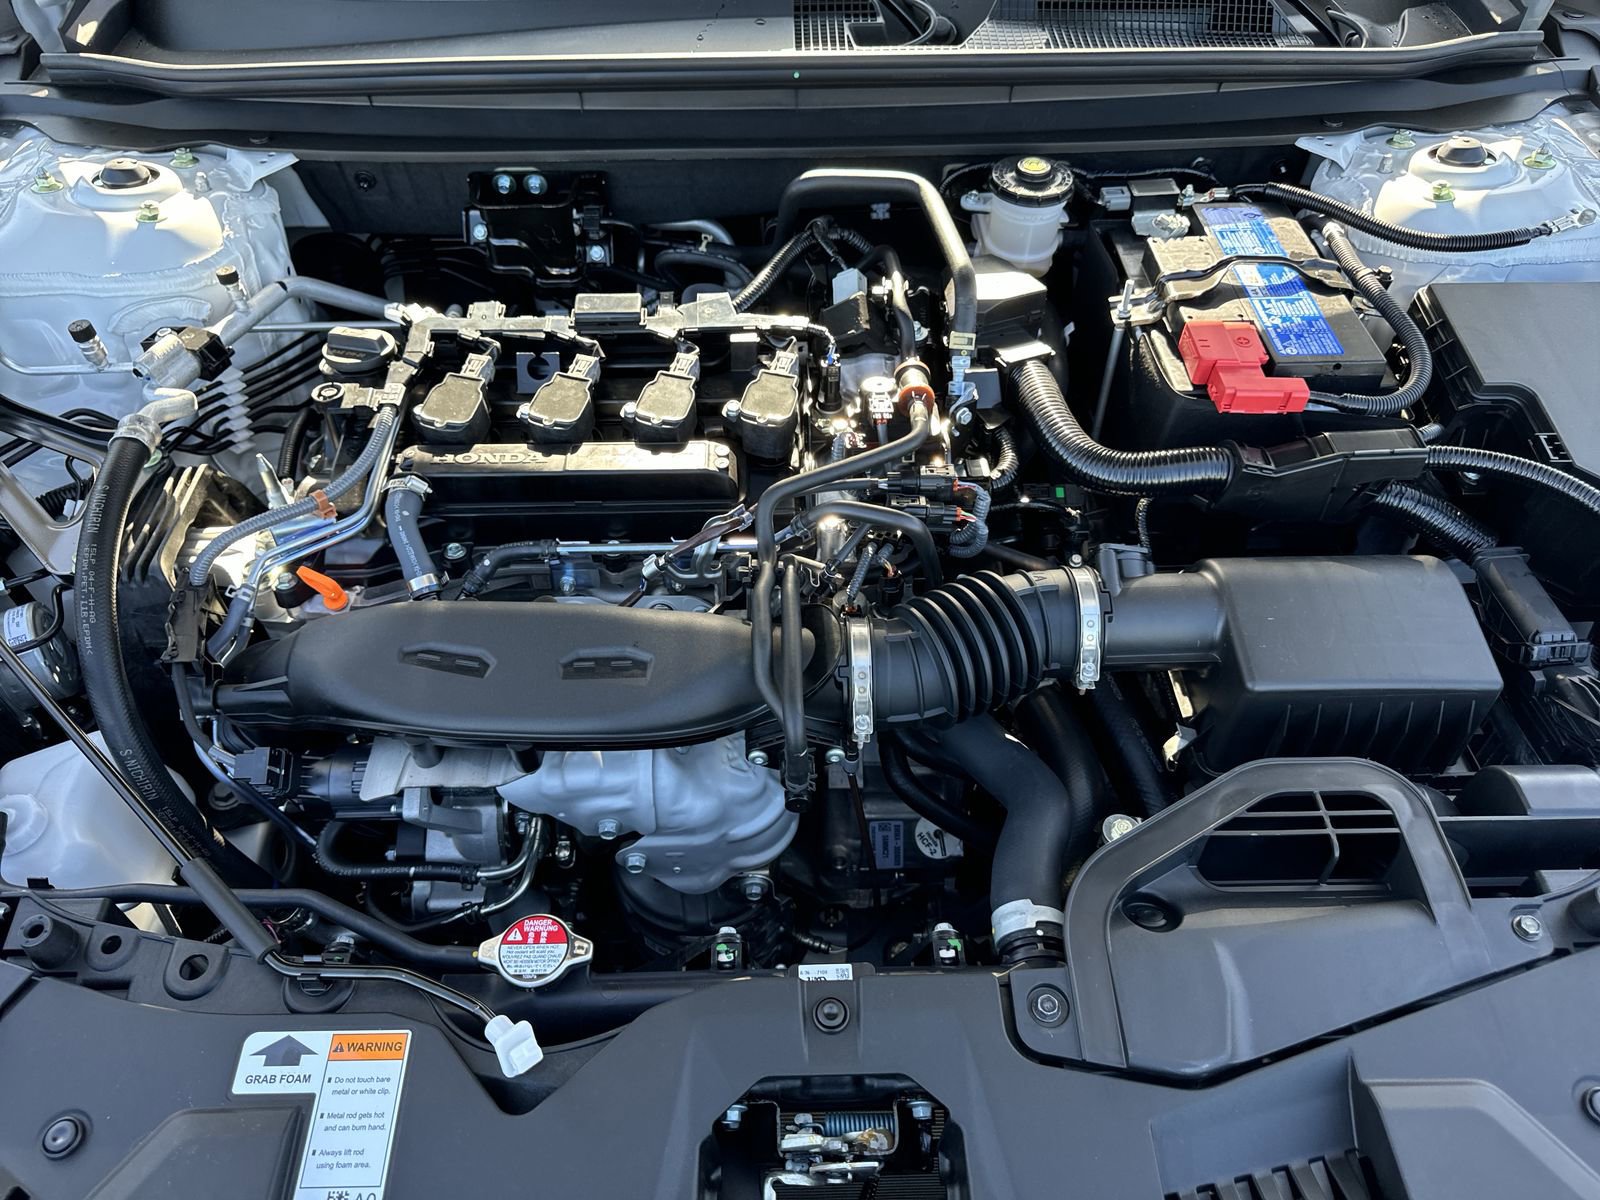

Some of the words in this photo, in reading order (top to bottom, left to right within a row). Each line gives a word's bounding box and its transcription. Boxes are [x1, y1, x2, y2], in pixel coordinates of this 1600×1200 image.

[433, 452, 547, 464] HONDA
[347, 1042, 403, 1052] WARNING
[245, 1074, 277, 1084] GRAB
[279, 1074, 312, 1084] FOAM
[358, 1112, 373, 1121] gets
[373, 1111, 385, 1119] hot
[318, 1149, 342, 1157] Always
[316, 1162, 334, 1170] using
[335, 1161, 352, 1169] foam
